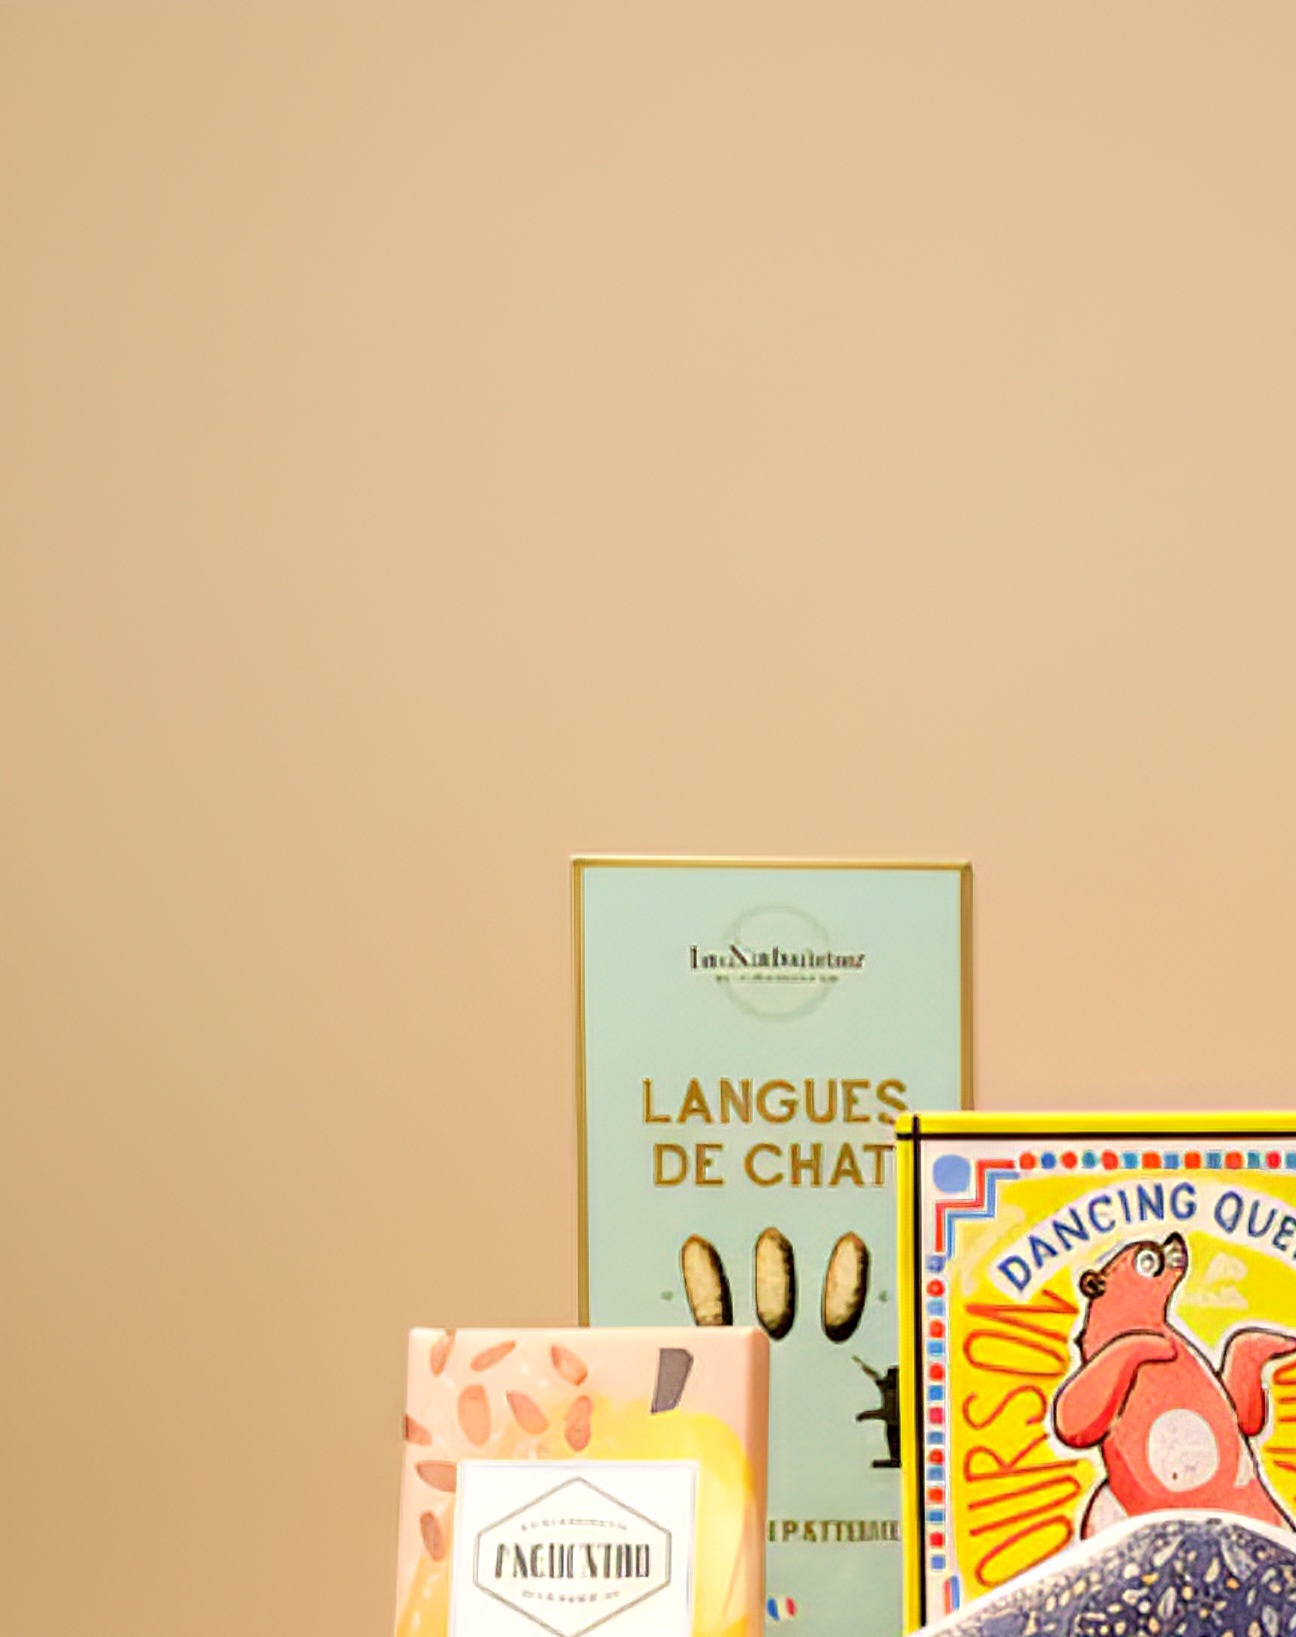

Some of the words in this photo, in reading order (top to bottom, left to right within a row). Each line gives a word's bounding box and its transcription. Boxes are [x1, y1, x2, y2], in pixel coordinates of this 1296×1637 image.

[643, 1077, 908, 1125] LANGUES
[652, 1142, 723, 1187] DE
[997, 1181, 1199, 1292] DANCING
[962, 1288, 1082, 1588] OURSON
